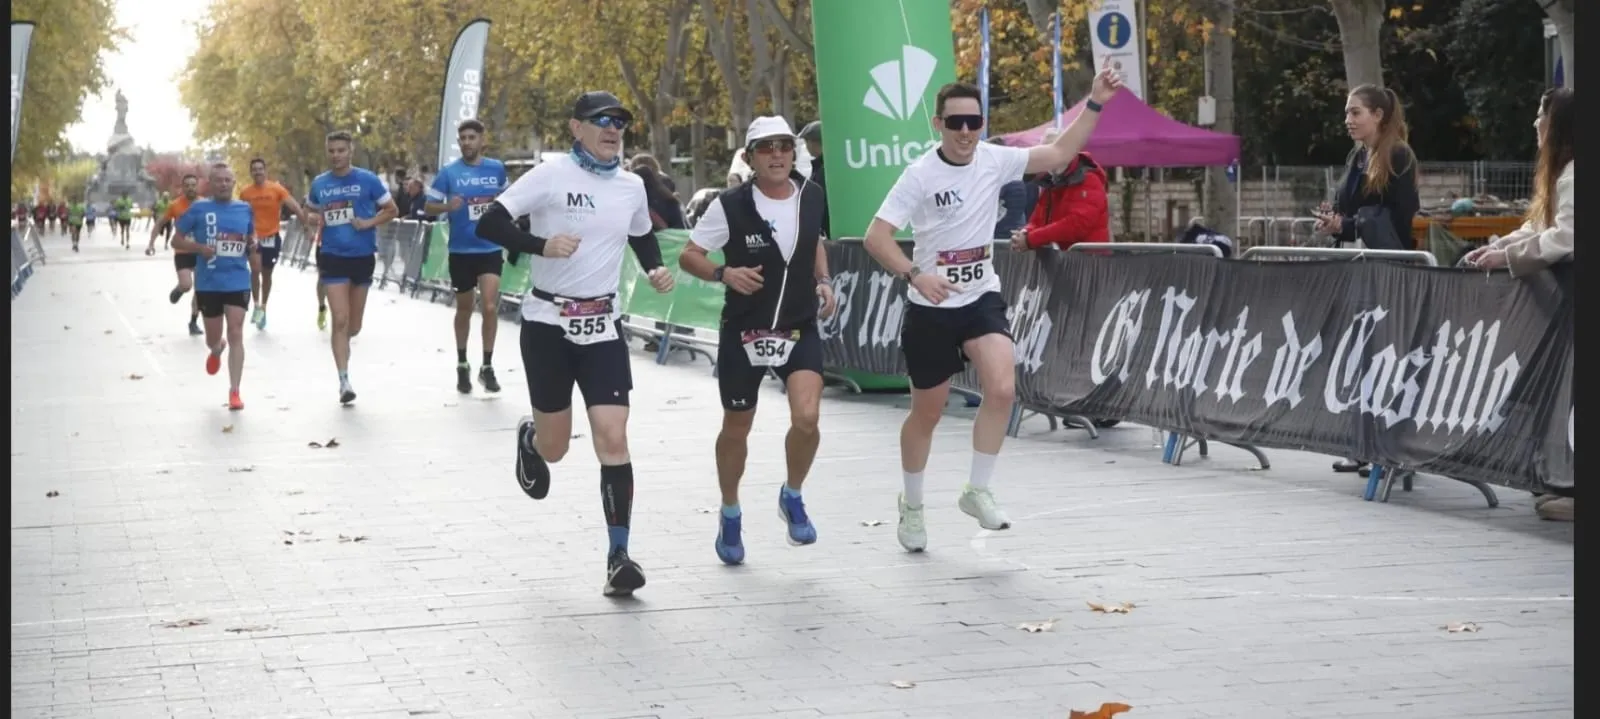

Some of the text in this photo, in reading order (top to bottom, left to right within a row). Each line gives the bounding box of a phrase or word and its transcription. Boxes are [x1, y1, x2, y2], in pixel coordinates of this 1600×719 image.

[845, 134, 937, 169] Unic
[457, 175, 498, 187] IVECO
[320, 184, 361, 198] IVECO
[935, 190, 963, 207] MX
[567, 192, 595, 208] MX
[327, 209, 347, 221] 571
[222, 243, 243, 252] 570
[745, 233, 764, 246] MX
[947, 263, 983, 284] 556
[568, 316, 606, 336] 555
[754, 339, 786, 358] 554
[1091, 288, 1151, 386] El
[1146, 286, 1262, 404] Norte
[1263, 310, 1323, 410] de
[1324, 304, 1521, 436] Castilla
